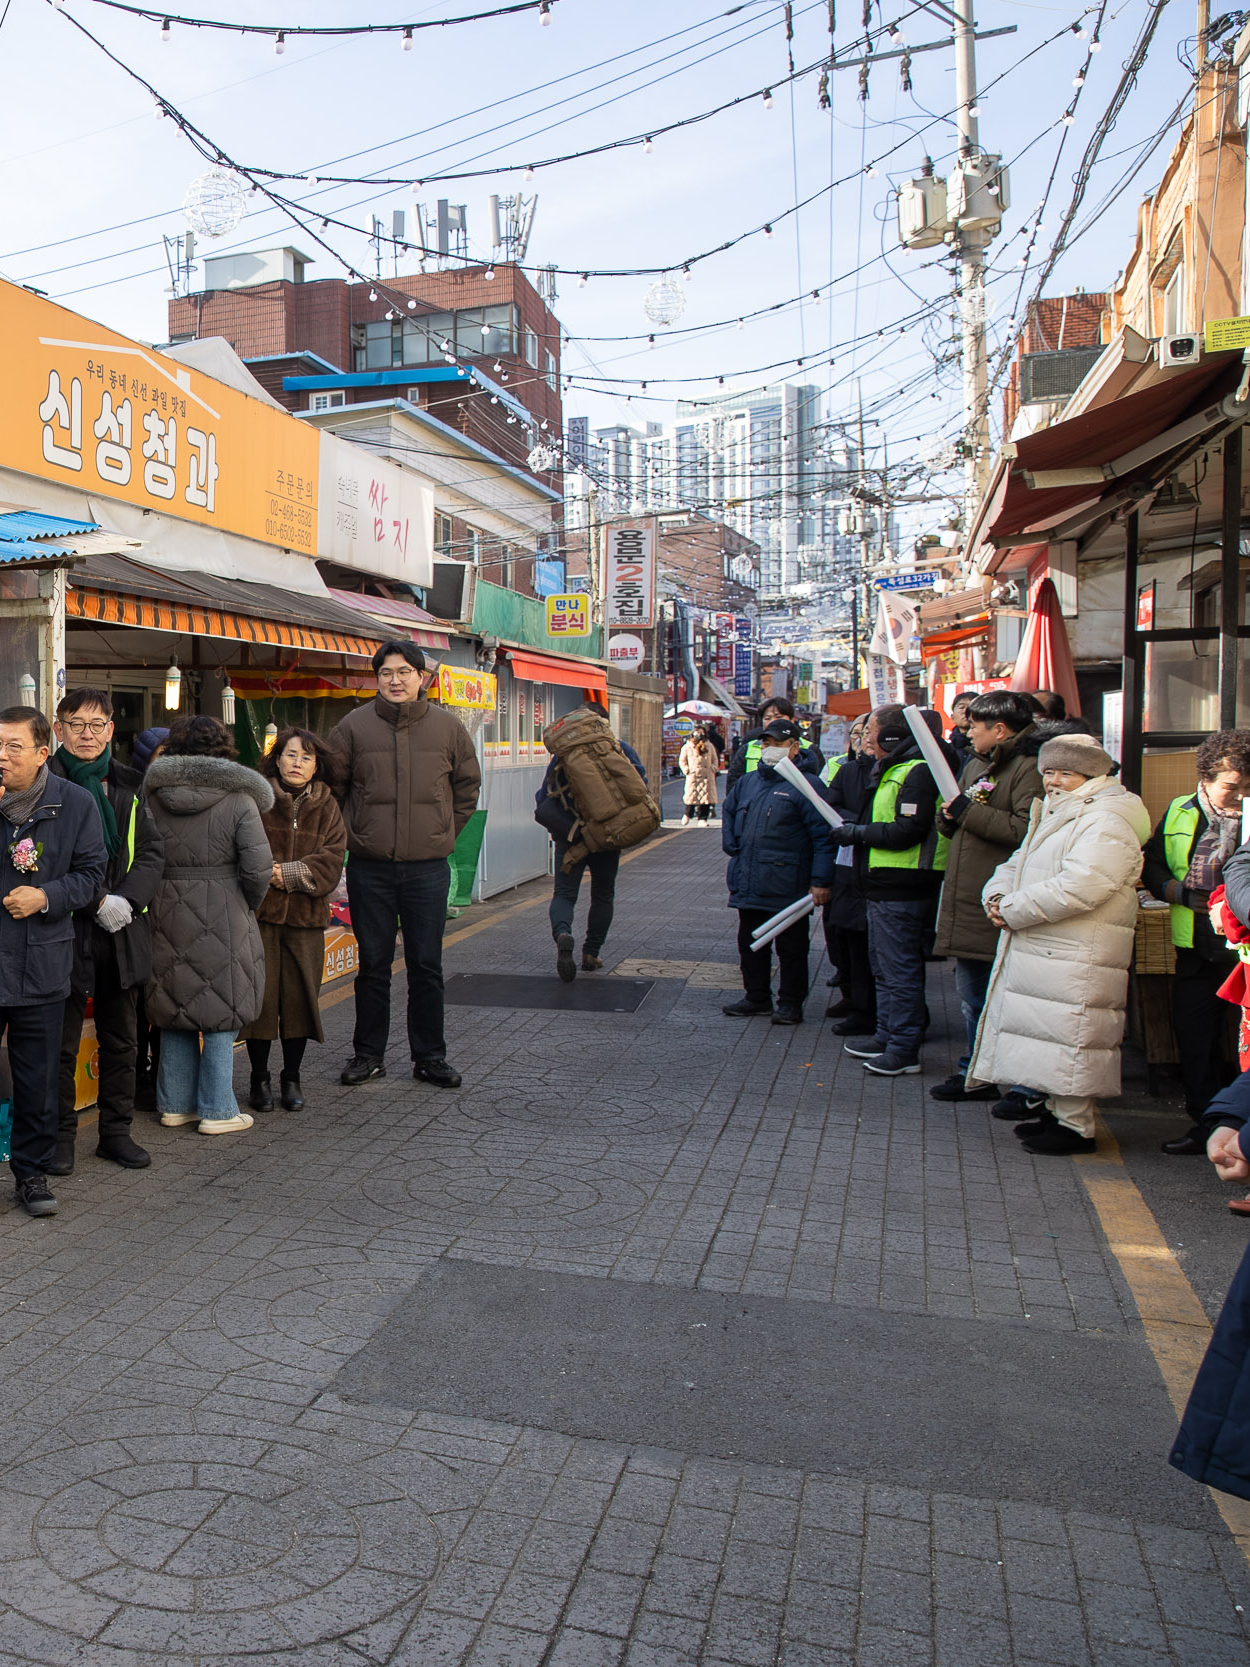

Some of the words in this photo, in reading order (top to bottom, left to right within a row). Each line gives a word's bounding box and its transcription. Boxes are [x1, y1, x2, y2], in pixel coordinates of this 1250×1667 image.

[86, 359, 104, 384] 우리
[109, 369, 126, 393] 동네
[131, 379, 147, 402] 신선
[151, 388, 167, 411] 과일
[171, 396, 186, 418] 맛집
[39, 368, 219, 514] 신성청과
[276, 469, 313, 504] 주문문의
[270, 499, 312, 528] 02-468-5532
[613, 529, 647, 617] 용문2호집
[555, 599, 580, 611] 만나
[551, 613, 585, 632] 분식
[609, 647, 638, 657] 파출부
